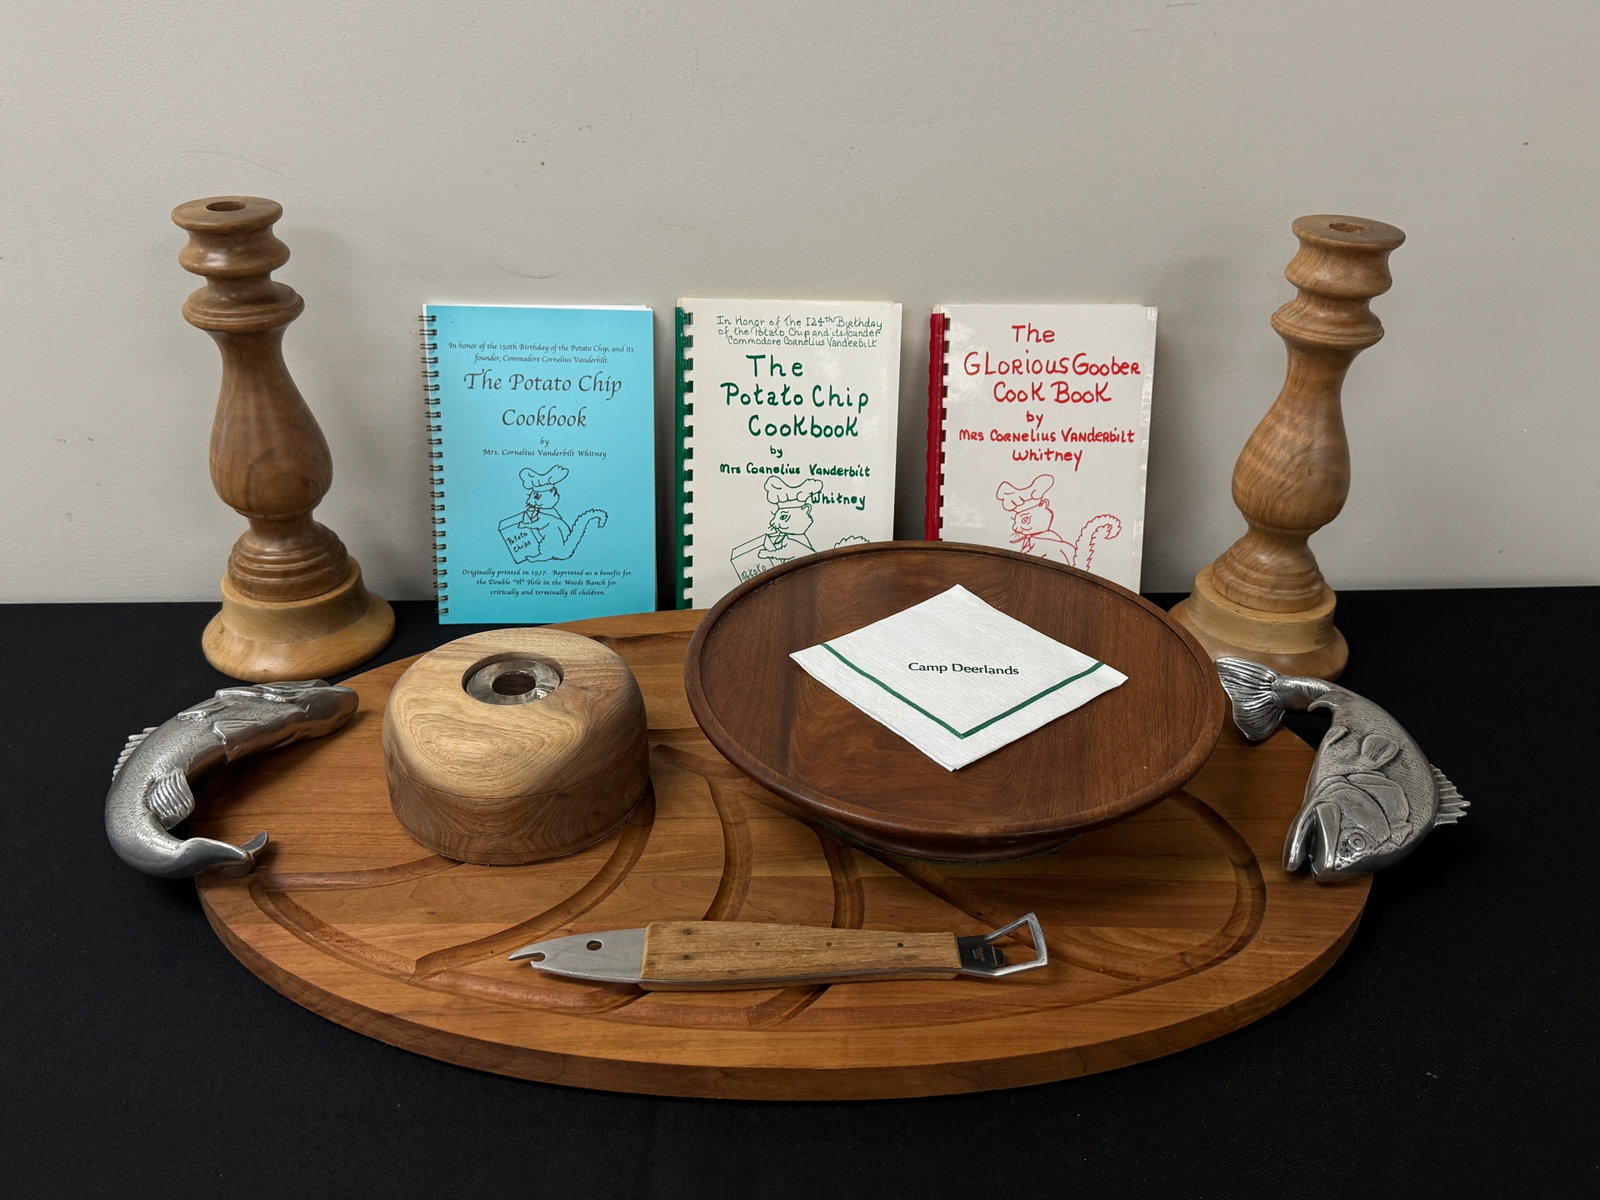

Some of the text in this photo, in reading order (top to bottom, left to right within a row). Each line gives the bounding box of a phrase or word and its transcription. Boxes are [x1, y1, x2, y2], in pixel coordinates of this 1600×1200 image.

[716, 315, 732, 325] In
[735, 315, 765, 326] Honor
[769, 316, 780, 329] of
[834, 316, 882, 331] Birthday
[718, 326, 729, 338] of
[734, 326, 749, 336] the
[751, 325, 785, 336] Potato
[812, 328, 829, 337] and
[830, 328, 843, 336] its
[844, 326, 881, 340] founder
[1011, 323, 1055, 343] The
[459, 341, 477, 349] honor
[479, 341, 487, 352] of
[487, 342, 497, 350] the
[500, 342, 517, 350] 150th
[519, 343, 549, 354] Birthday
[551, 343, 557, 354] of
[558, 343, 568, 351] the
[570, 344, 592, 352] Potato
[593, 343, 610, 355] Chip,
[612, 344, 624, 352] and
[728, 335, 781, 345] Commodore
[827, 337, 877, 348] Vanderbilt
[503, 353, 540, 362] Commodore
[542, 354, 571, 363] Cornelius
[745, 354, 804, 377] The
[463, 368, 622, 400] The Potato Chip
[720, 382, 869, 414] Potato Chip
[502, 405, 587, 427] Cookbook
[1026, 410, 1044, 430] by
[540, 437, 550, 447] by
[482, 448, 607, 460] Mrs. Cornelius Vanderbilt Whitney
[770, 445, 784, 458] by
[1012, 449, 1083, 471] Whitney
[720, 463, 741, 474] Mrs
[809, 491, 866, 511] Whitney
[506, 532, 528, 545] Potato
[462, 568, 495, 577] Originally
[496, 568, 521, 577] printed
[552, 569, 583, 578] Reprinted
[600, 569, 621, 578] benefit
[622, 569, 632, 578] for
[607, 579, 616, 588] for
[490, 588, 519, 598] critically
[535, 588, 568, 598] terminally
[579, 588, 605, 596] children.
[908, 662, 1020, 675] Camp Deerlands
